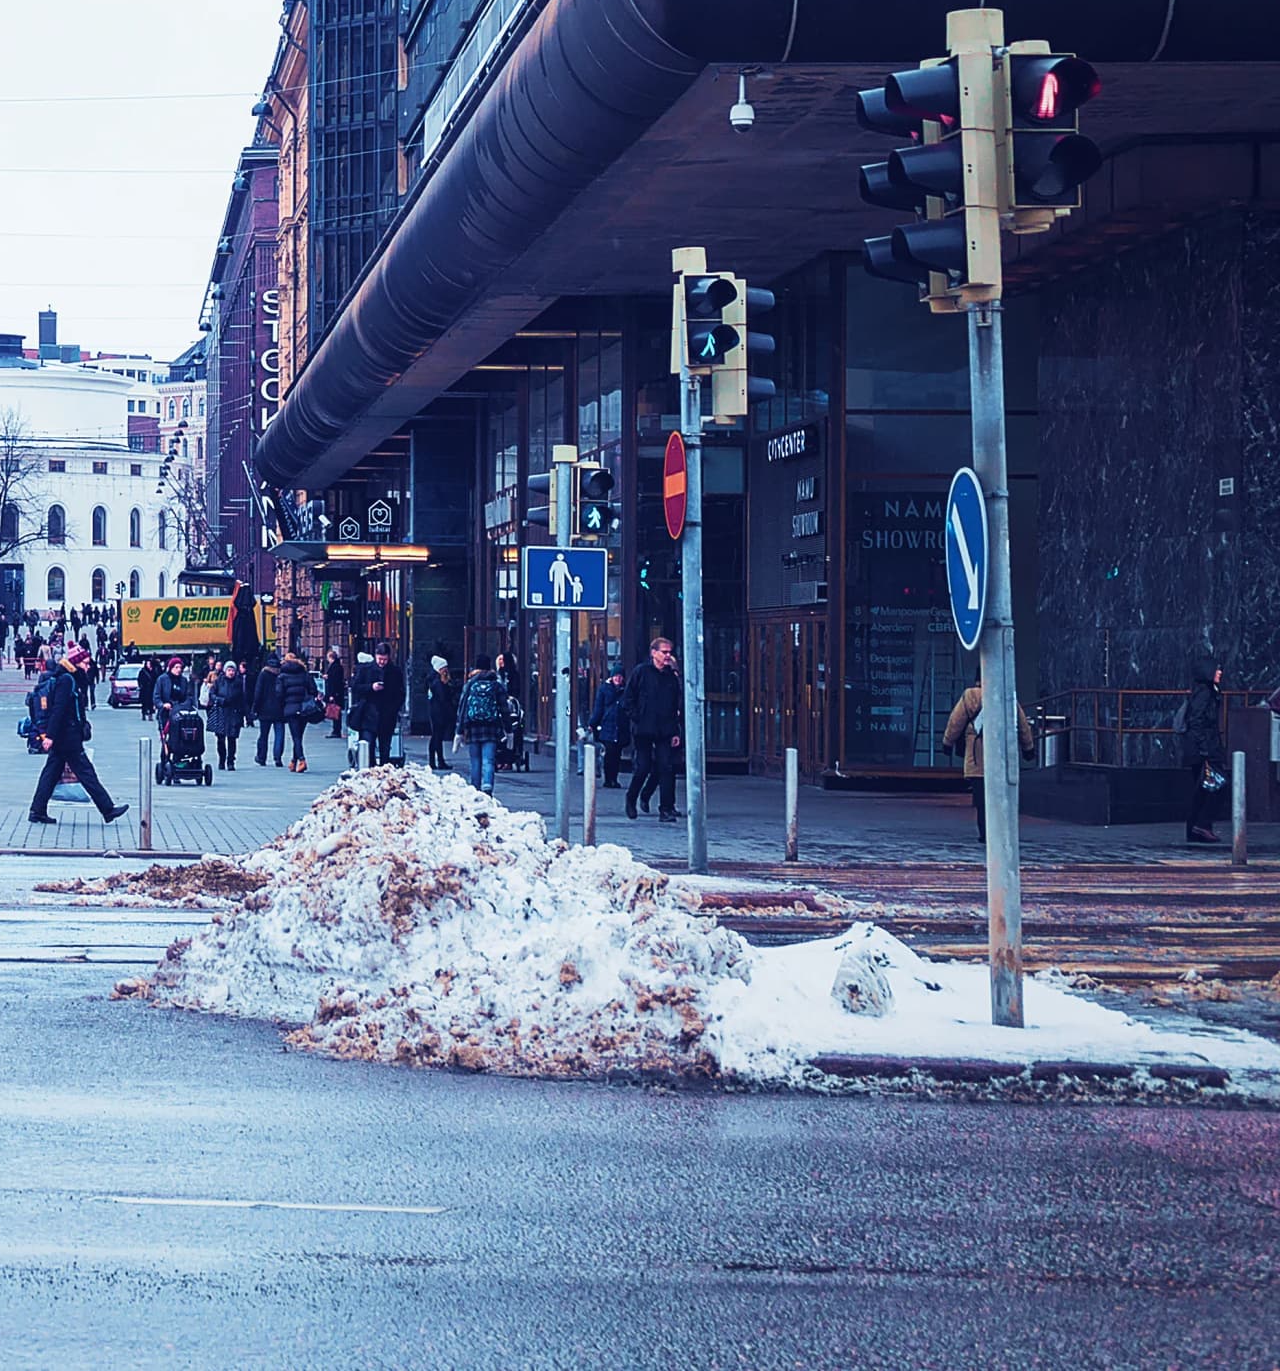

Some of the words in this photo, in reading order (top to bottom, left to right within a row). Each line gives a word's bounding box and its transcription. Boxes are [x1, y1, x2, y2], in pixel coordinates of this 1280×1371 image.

[884, 500, 942, 518] NAM
[862, 530, 946, 549] SHOWRO
[153, 605, 229, 631] FORSMAN
